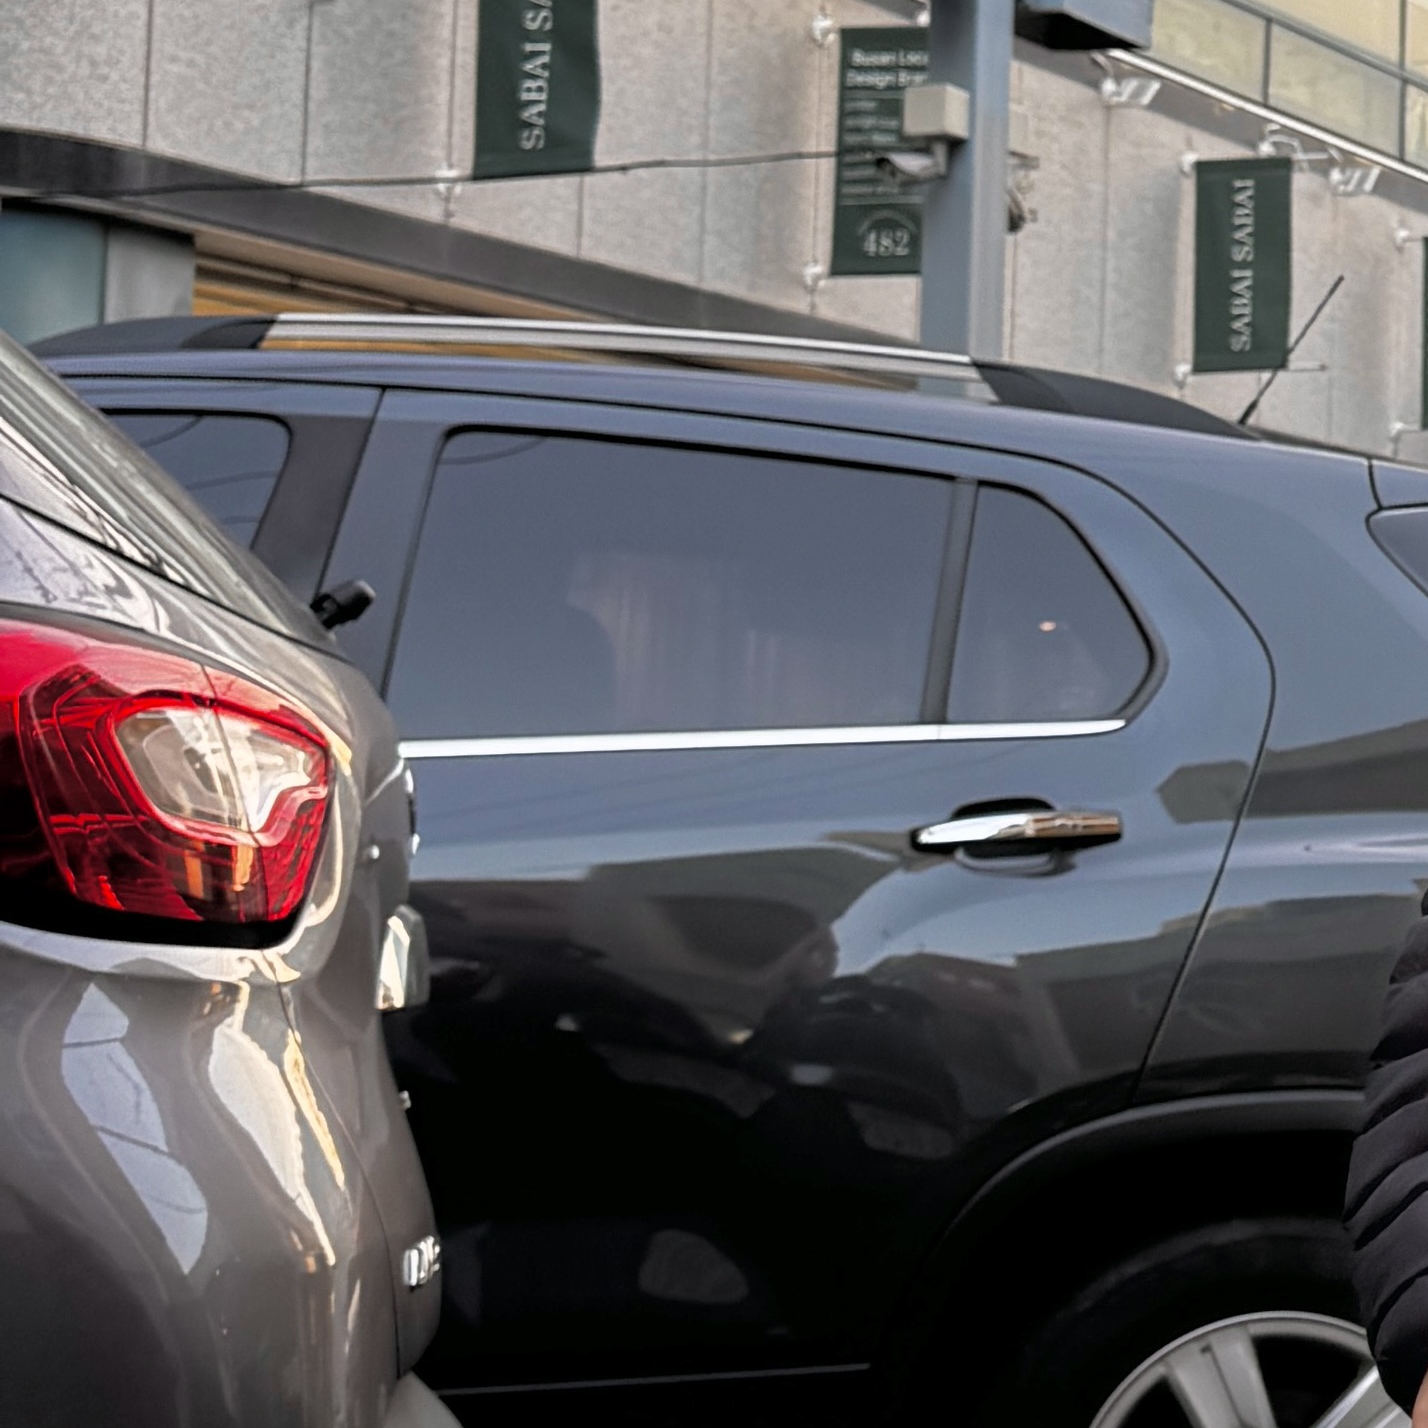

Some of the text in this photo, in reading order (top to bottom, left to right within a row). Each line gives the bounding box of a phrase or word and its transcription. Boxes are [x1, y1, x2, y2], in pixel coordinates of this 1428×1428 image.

[518, 42, 552, 150] SABAI
[863, 228, 910, 258] 482
[1228, 179, 1255, 352] SABAI SABAI
